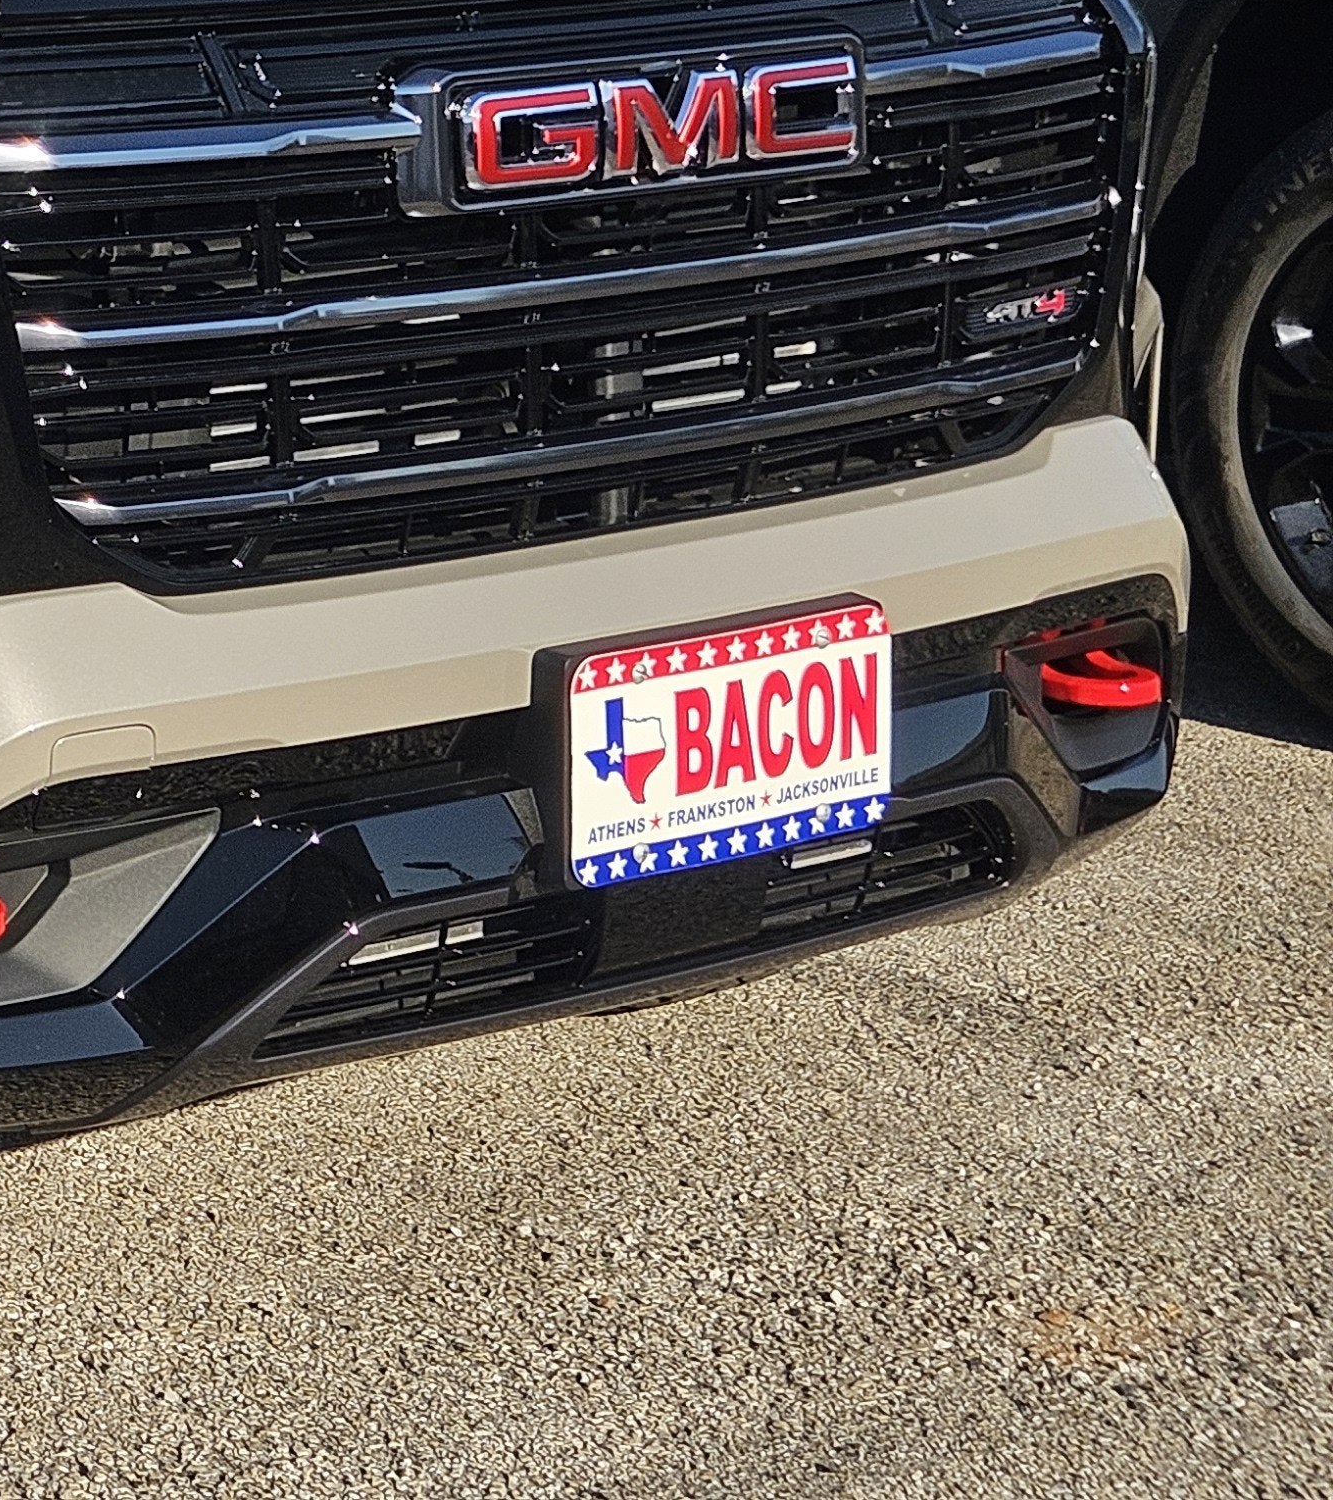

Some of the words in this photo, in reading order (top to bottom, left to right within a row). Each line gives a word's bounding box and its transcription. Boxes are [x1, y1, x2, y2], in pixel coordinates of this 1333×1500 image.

[465, 54, 857, 190] GMC
[674, 652, 878, 797] BACON
[587, 817, 646, 845] ATHENS
[667, 794, 756, 828] FRANKSTON
[776, 767, 879, 805] JACKSONVILLE
